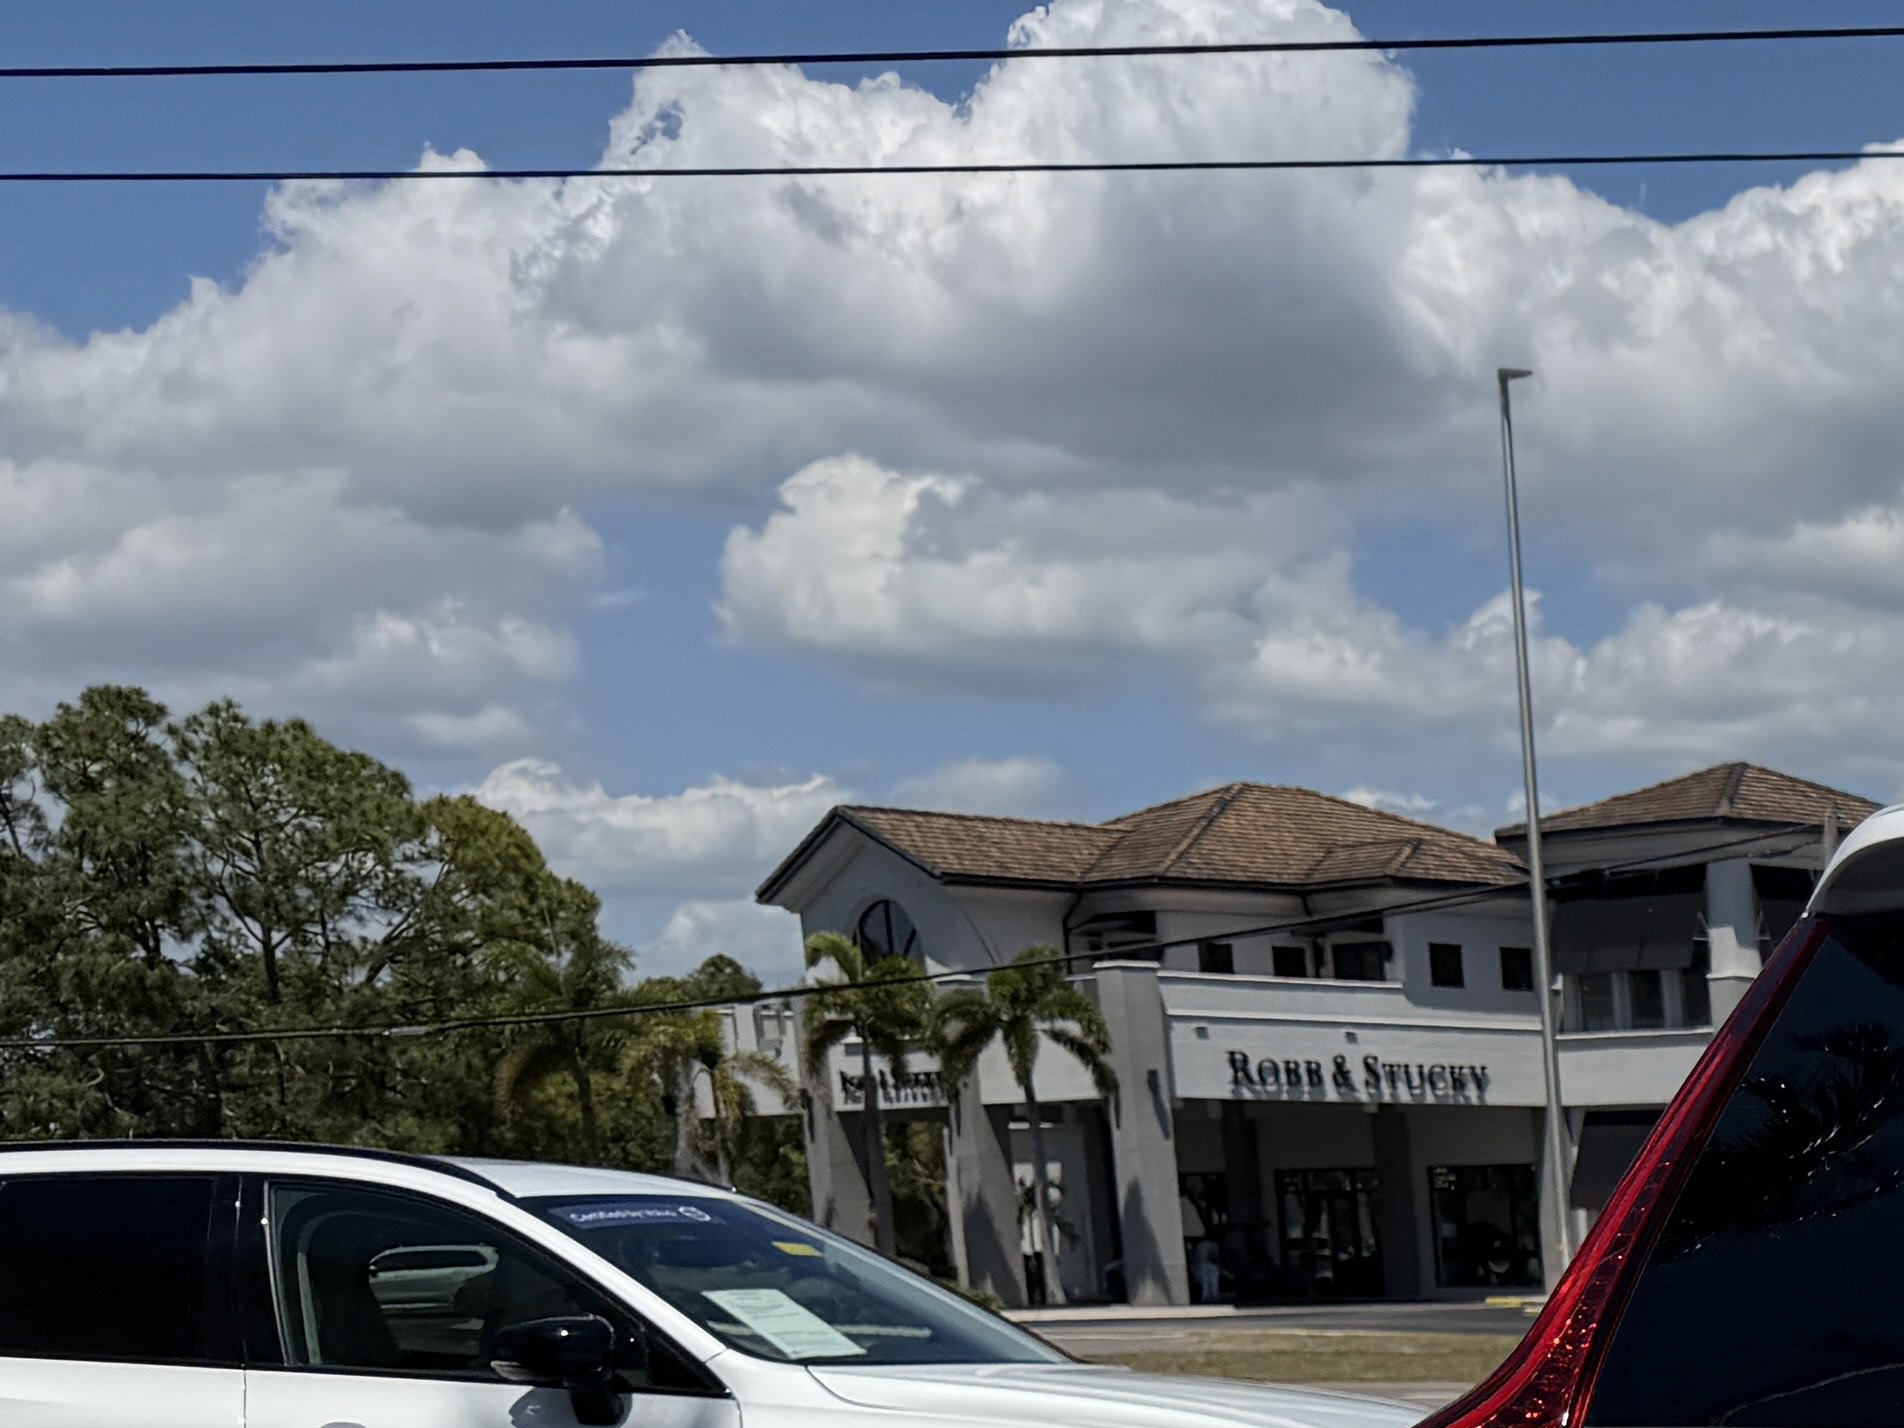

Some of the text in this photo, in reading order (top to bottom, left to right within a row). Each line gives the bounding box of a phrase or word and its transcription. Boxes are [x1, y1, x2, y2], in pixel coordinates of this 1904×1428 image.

[1226, 1050, 1488, 1097] ROBB & STUCKY
